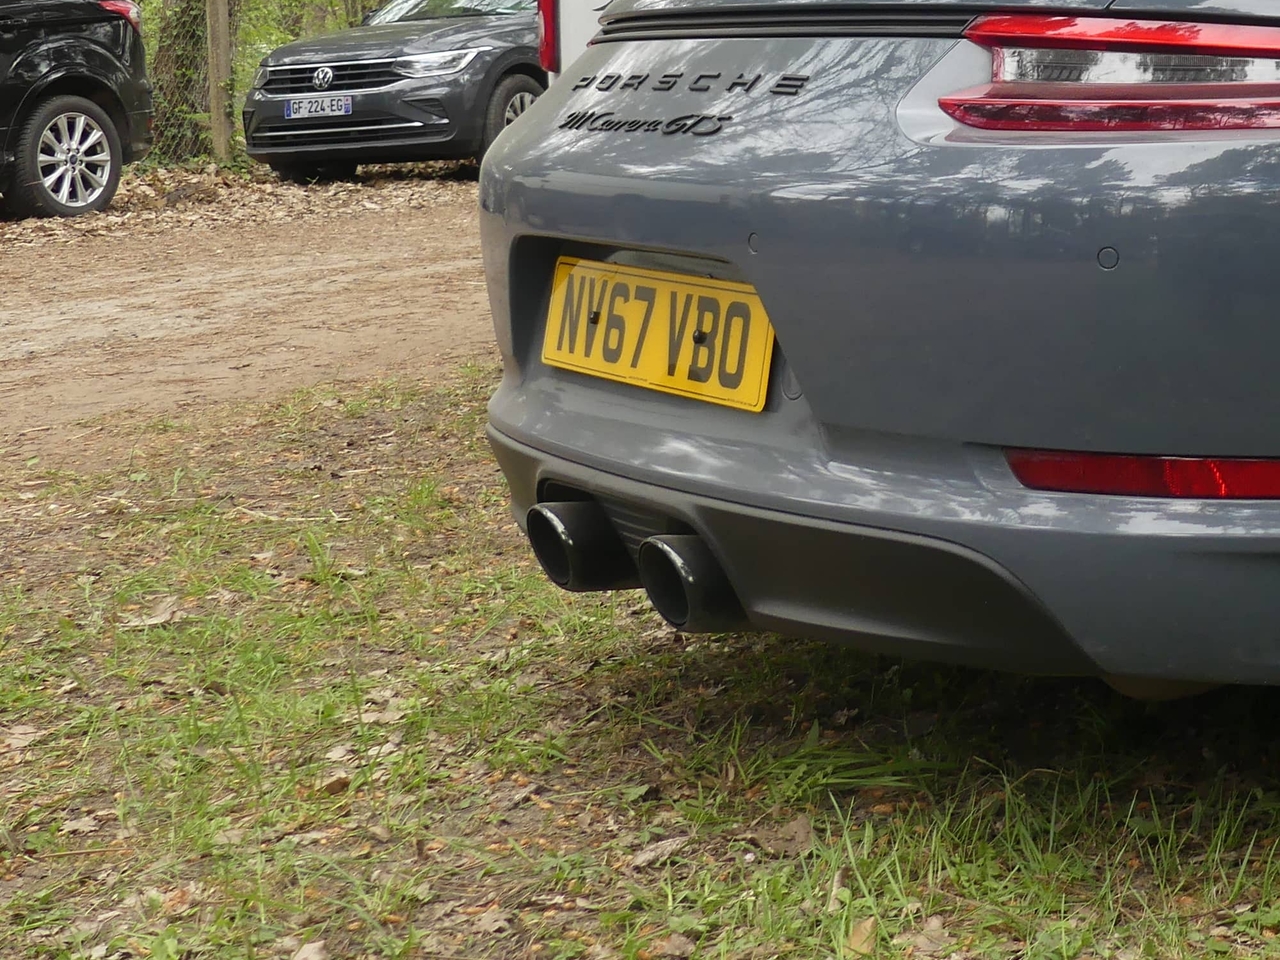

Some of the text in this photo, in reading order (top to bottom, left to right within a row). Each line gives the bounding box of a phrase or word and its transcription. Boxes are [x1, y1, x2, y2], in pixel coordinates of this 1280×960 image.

[571, 72, 810, 96] PORSCHE
[587, 112, 661, 133] Carrera
[661, 113, 733, 136] GTS
[556, 273, 751, 390] NV67 VBO
